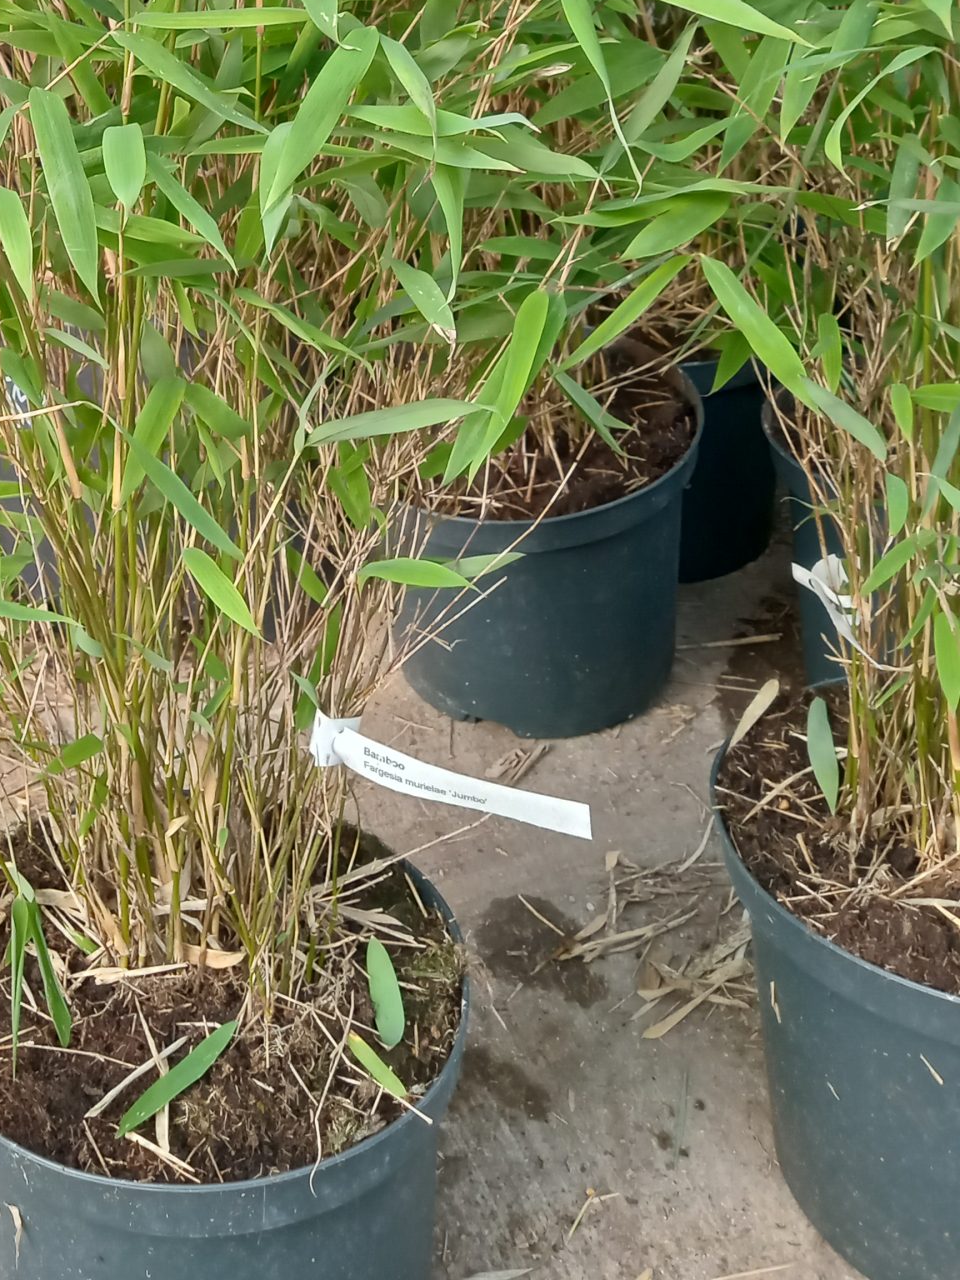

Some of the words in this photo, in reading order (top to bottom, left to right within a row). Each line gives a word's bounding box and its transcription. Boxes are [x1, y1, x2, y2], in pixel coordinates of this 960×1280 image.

[363, 746, 405, 771] Bamboo
[363, 760, 403, 783] Fargesia
[405, 778, 447, 796] murielae
